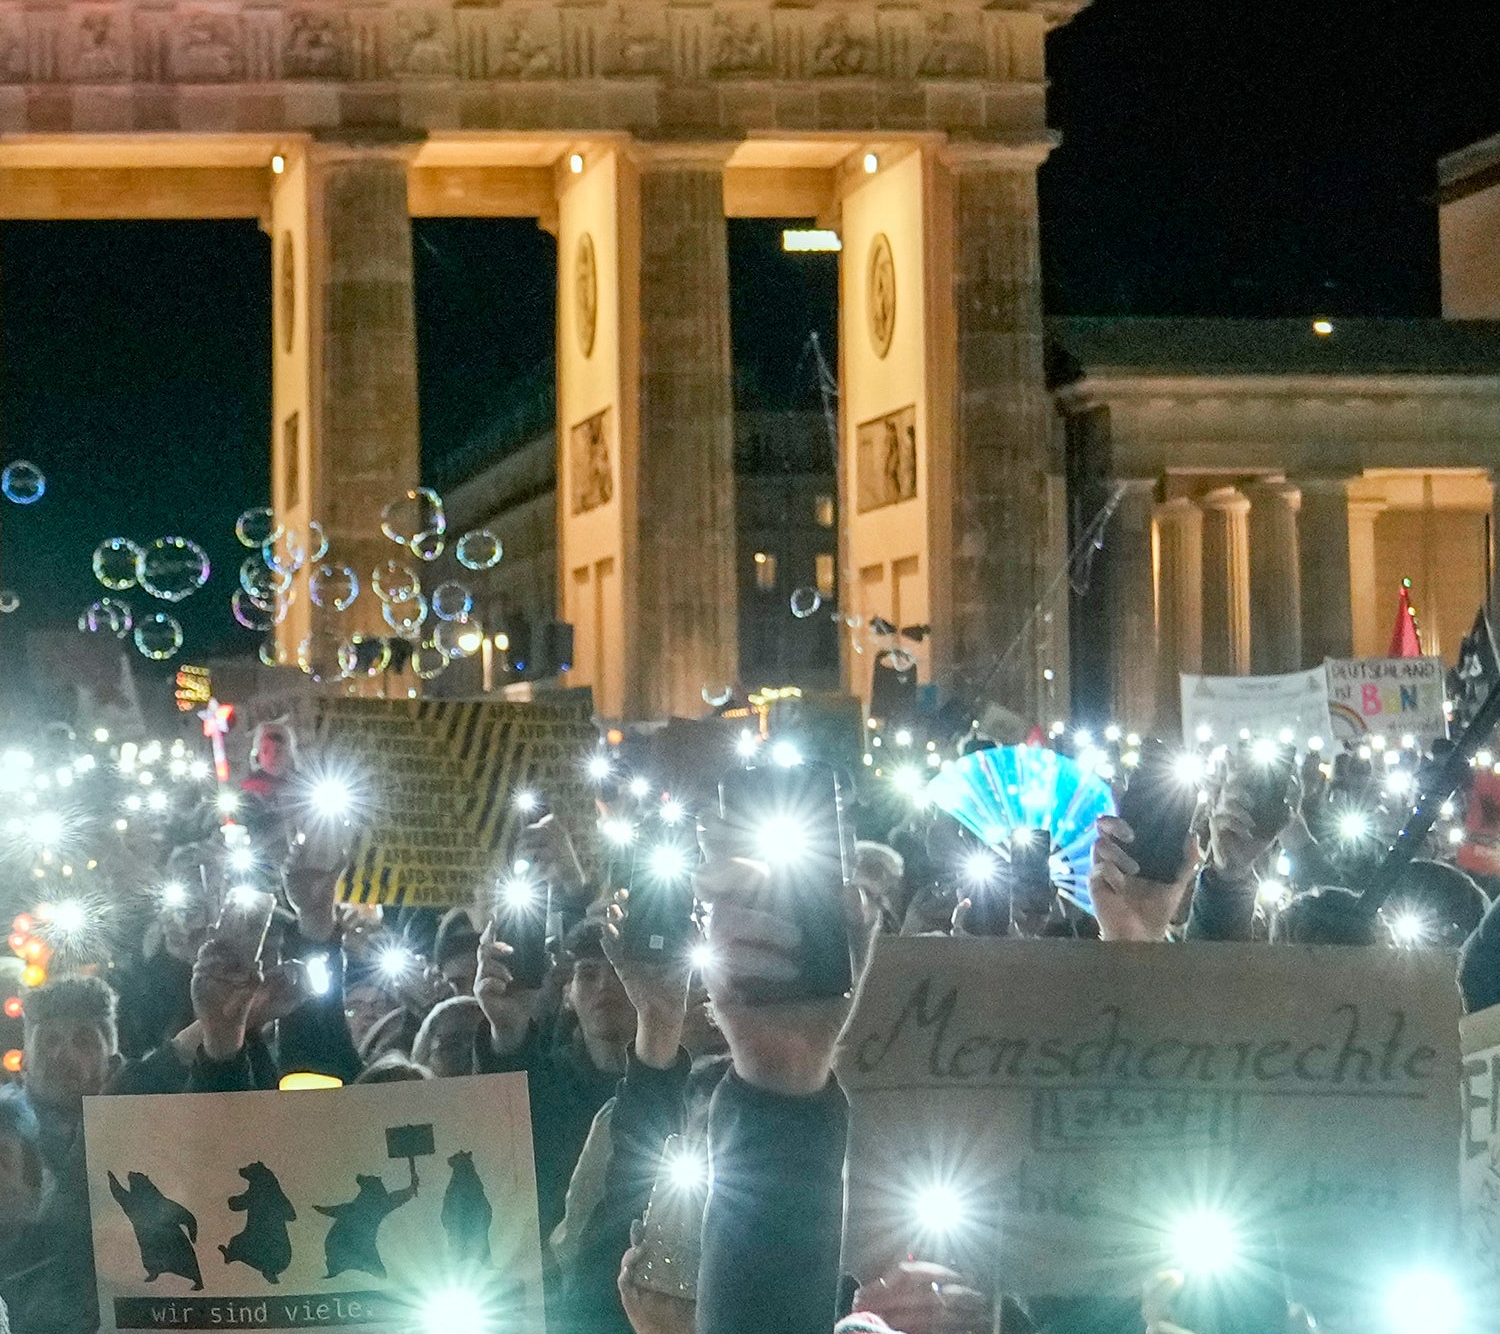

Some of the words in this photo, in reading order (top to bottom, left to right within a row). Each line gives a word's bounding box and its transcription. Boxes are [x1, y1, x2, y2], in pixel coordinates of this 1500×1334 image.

[854, 976, 1436, 1081] Menschenrechte
[151, 1303, 194, 1326] wir
[210, 1300, 268, 1324] sind
